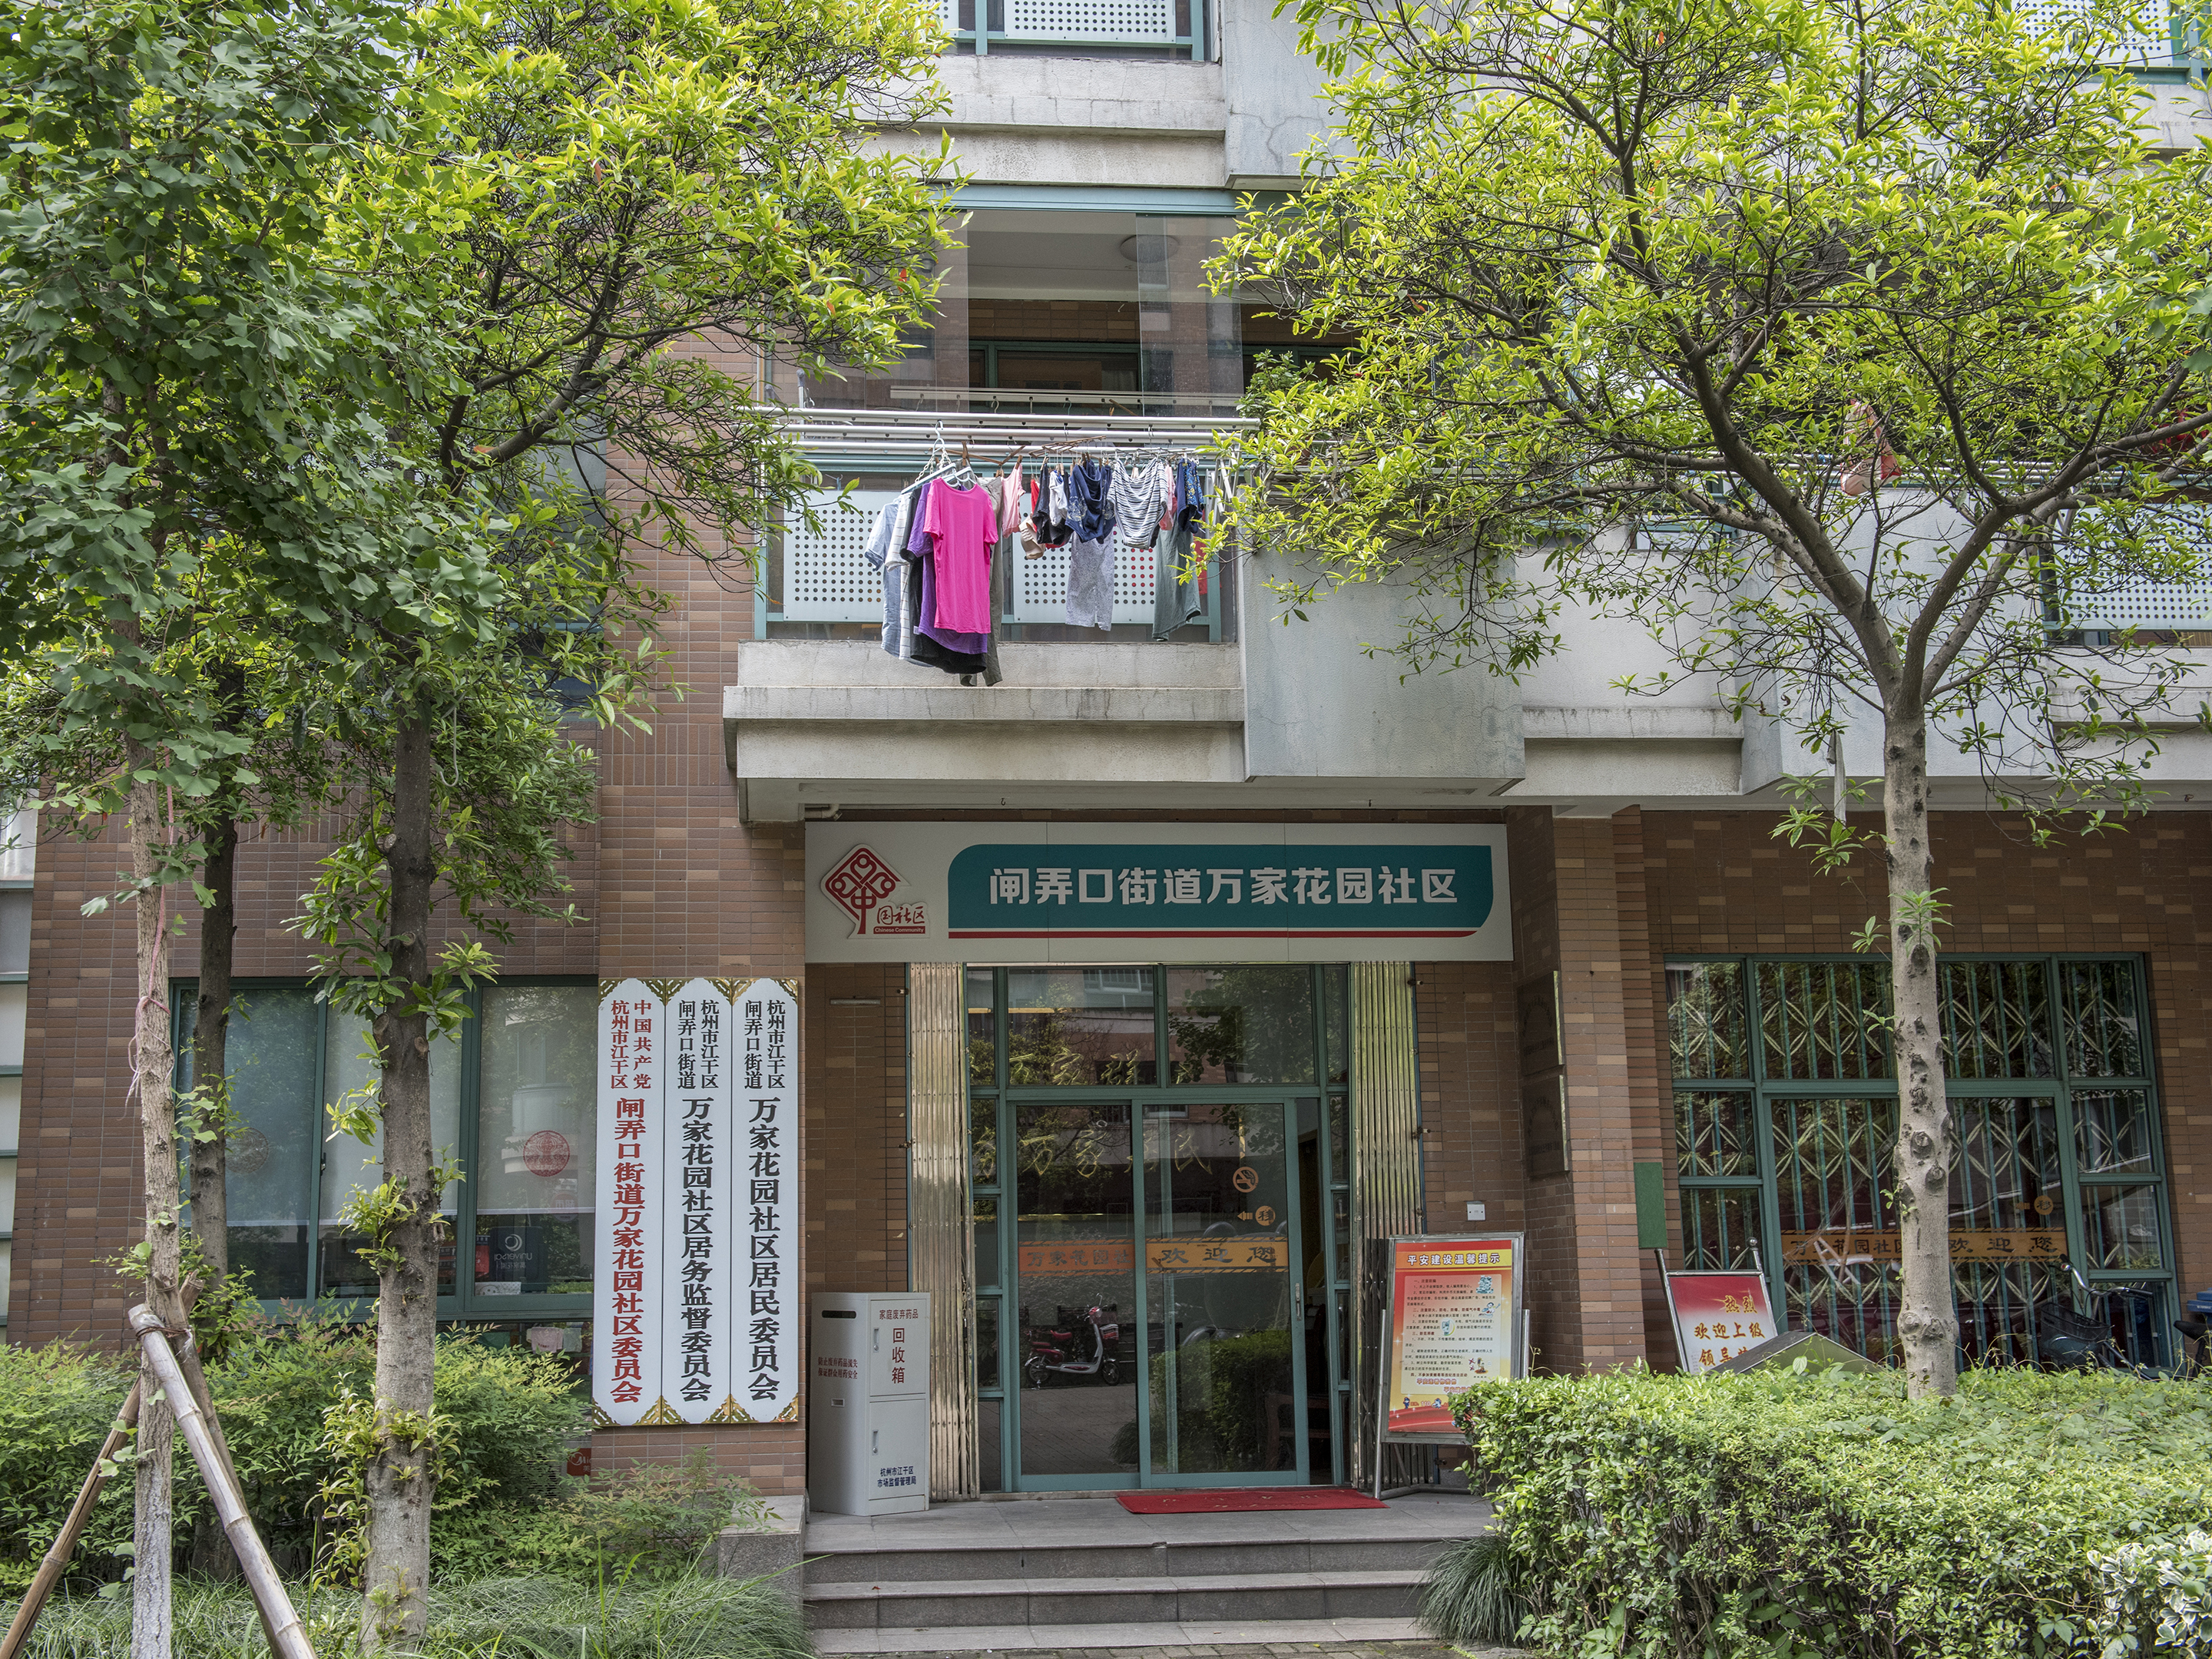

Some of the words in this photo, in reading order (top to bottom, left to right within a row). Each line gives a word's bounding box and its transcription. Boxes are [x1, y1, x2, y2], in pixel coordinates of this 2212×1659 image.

[988, 865, 1459, 906] 闸弄口街道万家花园社区
[611, 999, 630, 1089] 杭州市江干区
[633, 999, 652, 1090] 中国共产党
[677, 999, 697, 1090] 闸弄口街道
[700, 999, 720, 1089] 杭州市江干区
[744, 999, 763, 1090] 闸弄口街道
[767, 999, 786, 1089] 杭州市江干区
[611, 1098, 647, 1403] 闸弄口街道万家花园社区委员会
[680, 1097, 714, 1402] 万家花园社区居务监督委员会
[748, 1097, 781, 1401] 万家花园社区居民委员会
[1161, 1247, 1277, 1263] 欢迎您
[1407, 1253, 1501, 1266] 平安建设温馨提示
[1948, 1236, 2058, 1253] 欢迎您
[879, 1309, 919, 1320] 家庭废弃药品
[1724, 1295, 1758, 1313] 热烈
[1694, 1322, 1766, 1339] 欢迎上级
[818, 1367, 859, 1380] 保证群众用药安全
[892, 1327, 906, 1384] 回收箱
[877, 1476, 916, 1488] 市场监督管理局
[879, 1465, 914, 1477] 杭州市江干区
